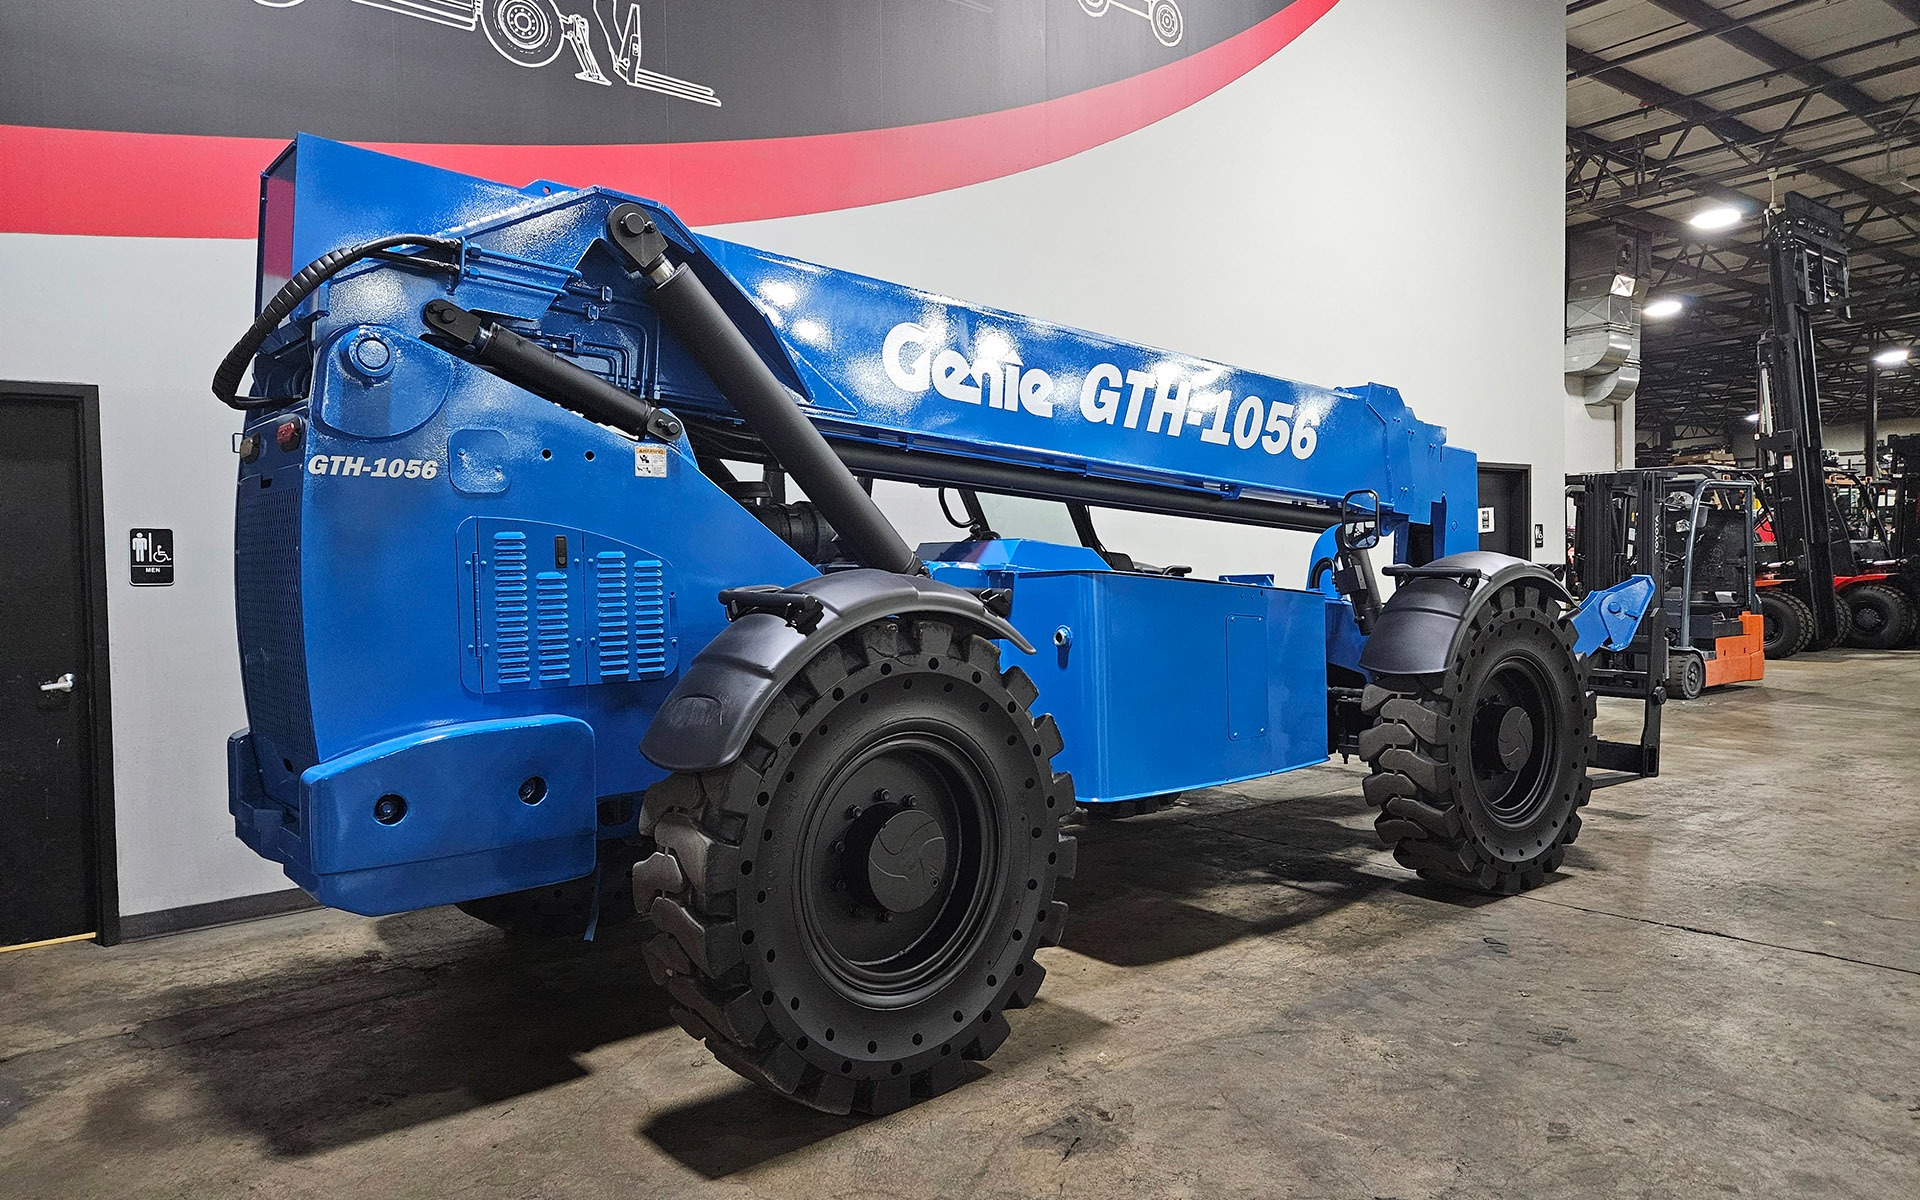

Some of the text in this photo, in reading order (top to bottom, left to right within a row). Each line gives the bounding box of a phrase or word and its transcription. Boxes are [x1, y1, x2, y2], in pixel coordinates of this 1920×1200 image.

[882, 321, 1321, 460] Genie GTH-1056
[307, 454, 438, 480] GTH-1056
